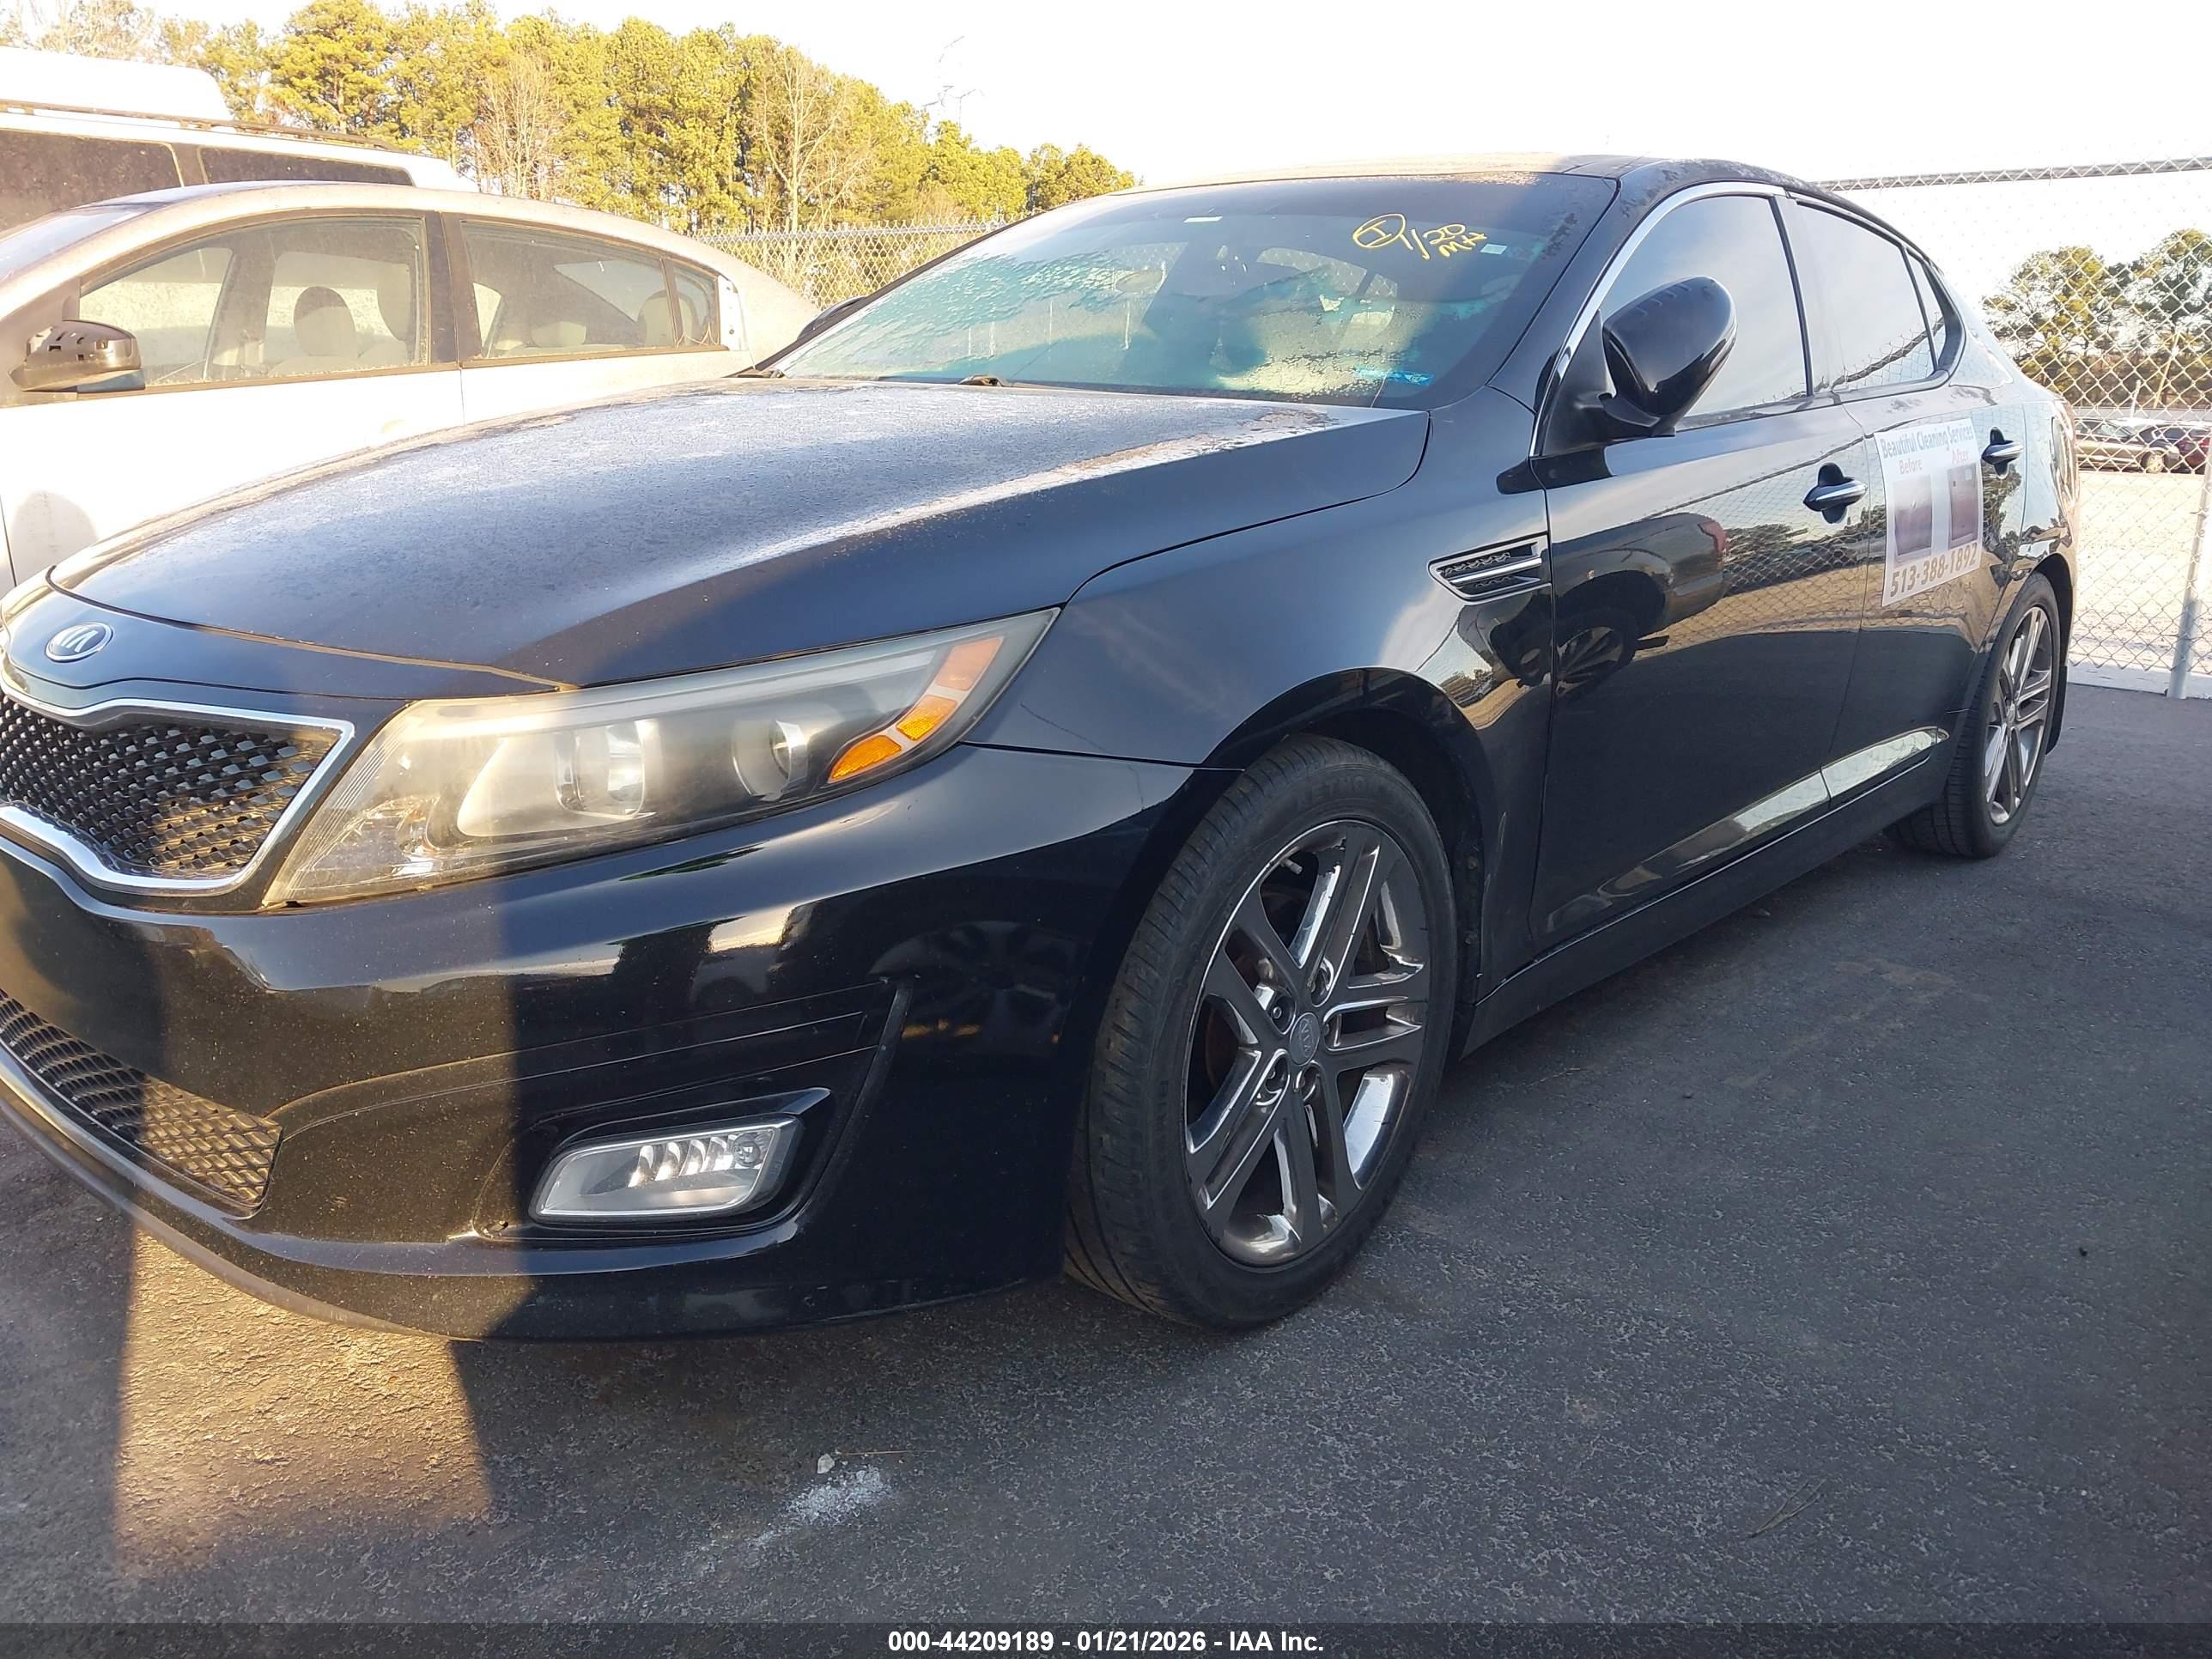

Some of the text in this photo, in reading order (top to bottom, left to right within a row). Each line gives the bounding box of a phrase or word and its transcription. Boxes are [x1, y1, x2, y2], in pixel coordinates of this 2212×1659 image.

[1881, 426, 1974, 459] Beautiful Cleaning Services
[1899, 459, 1923, 475] Before
[1889, 542, 1978, 598] 513-388-1892
